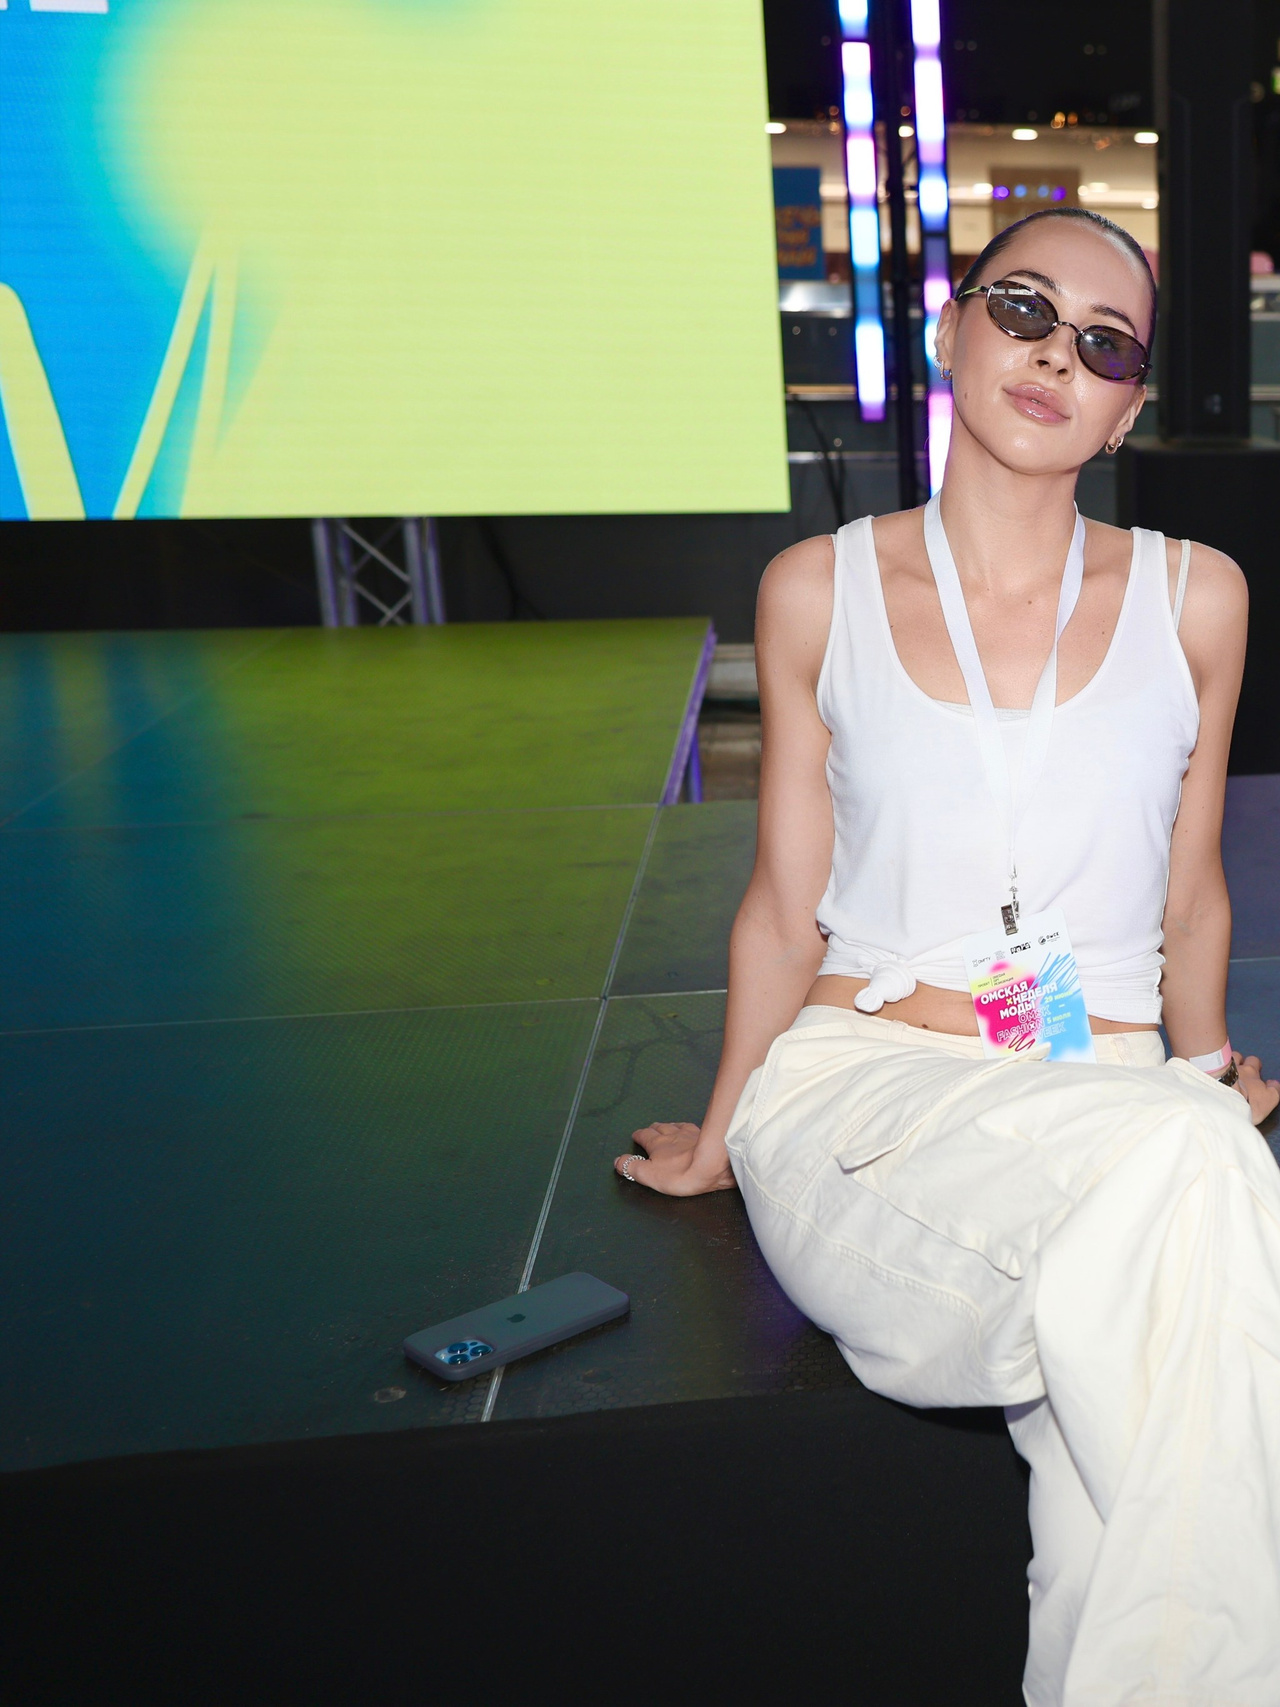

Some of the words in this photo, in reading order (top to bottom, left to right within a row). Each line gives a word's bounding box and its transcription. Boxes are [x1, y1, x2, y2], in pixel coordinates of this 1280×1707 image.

[980, 981, 1029, 1005] ОМСКАЯ
[1013, 982, 1058, 1005] НЕДЕЛЯ
[1000, 1000, 1036, 1020] МОДЫ
[1018, 1005, 1052, 1023] OMSK
[996, 1018, 1046, 1042] FASHION
[1031, 1021, 1067, 1042] WEEK
